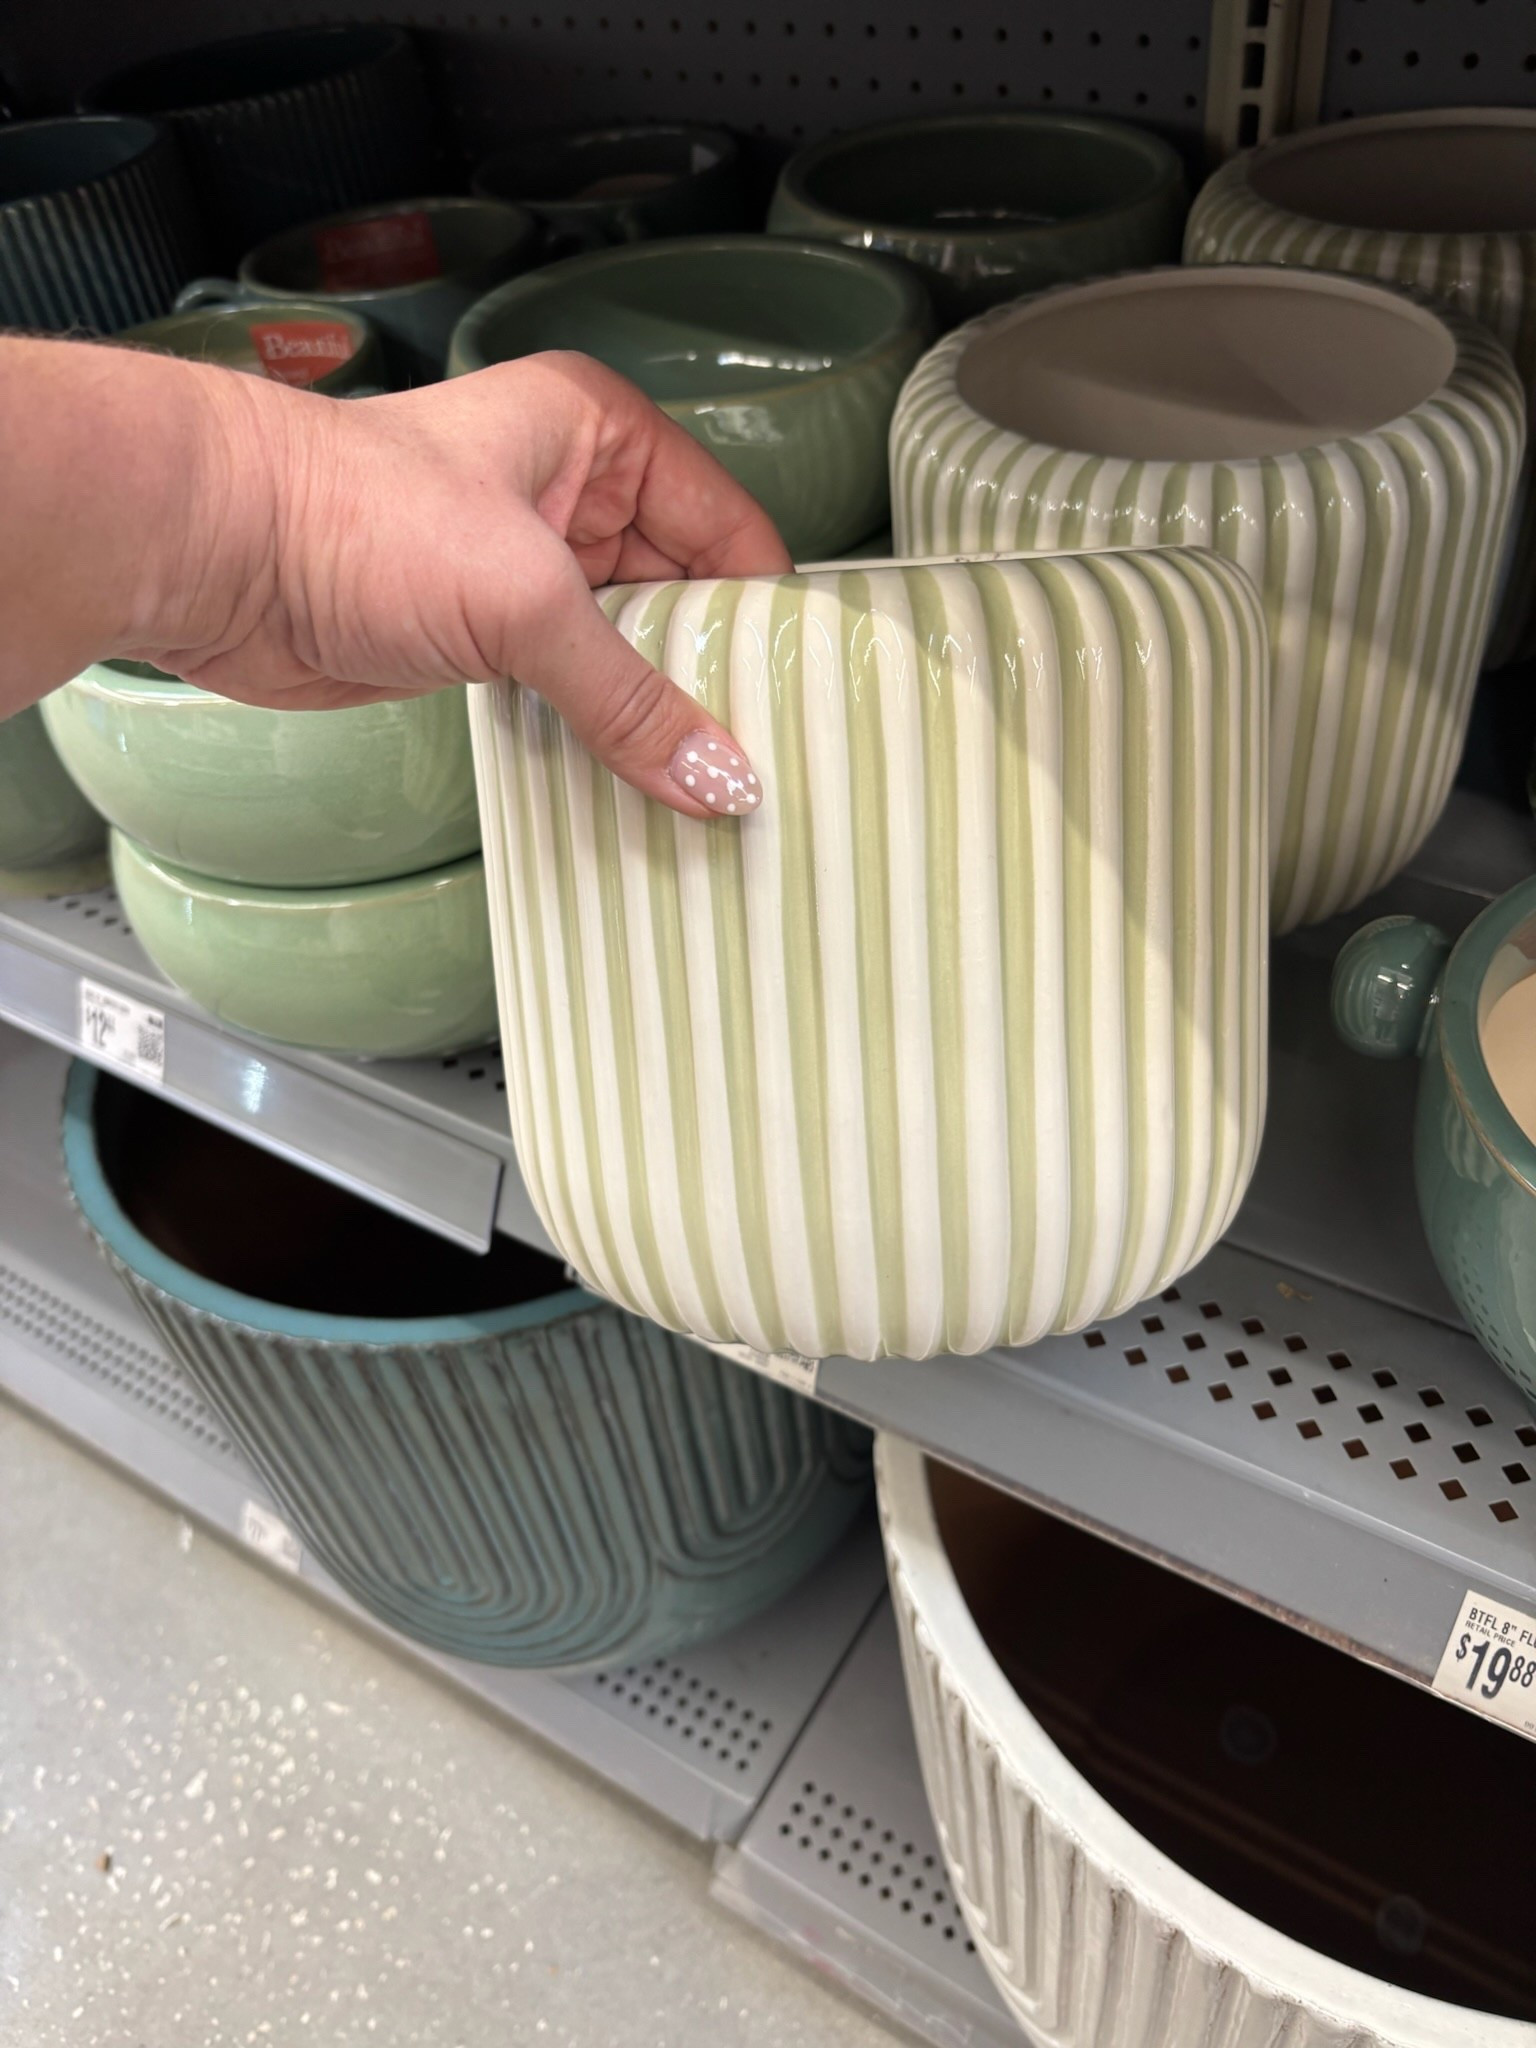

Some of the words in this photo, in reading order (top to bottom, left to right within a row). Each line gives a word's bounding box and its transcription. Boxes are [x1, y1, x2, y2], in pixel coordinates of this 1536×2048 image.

[1465, 1620, 1491, 1637] RETAIL
[1493, 1633, 1516, 1648] PRICE
[1469, 1607, 1498, 1631] BTFL
[1502, 1622, 1518, 1636] 8"
